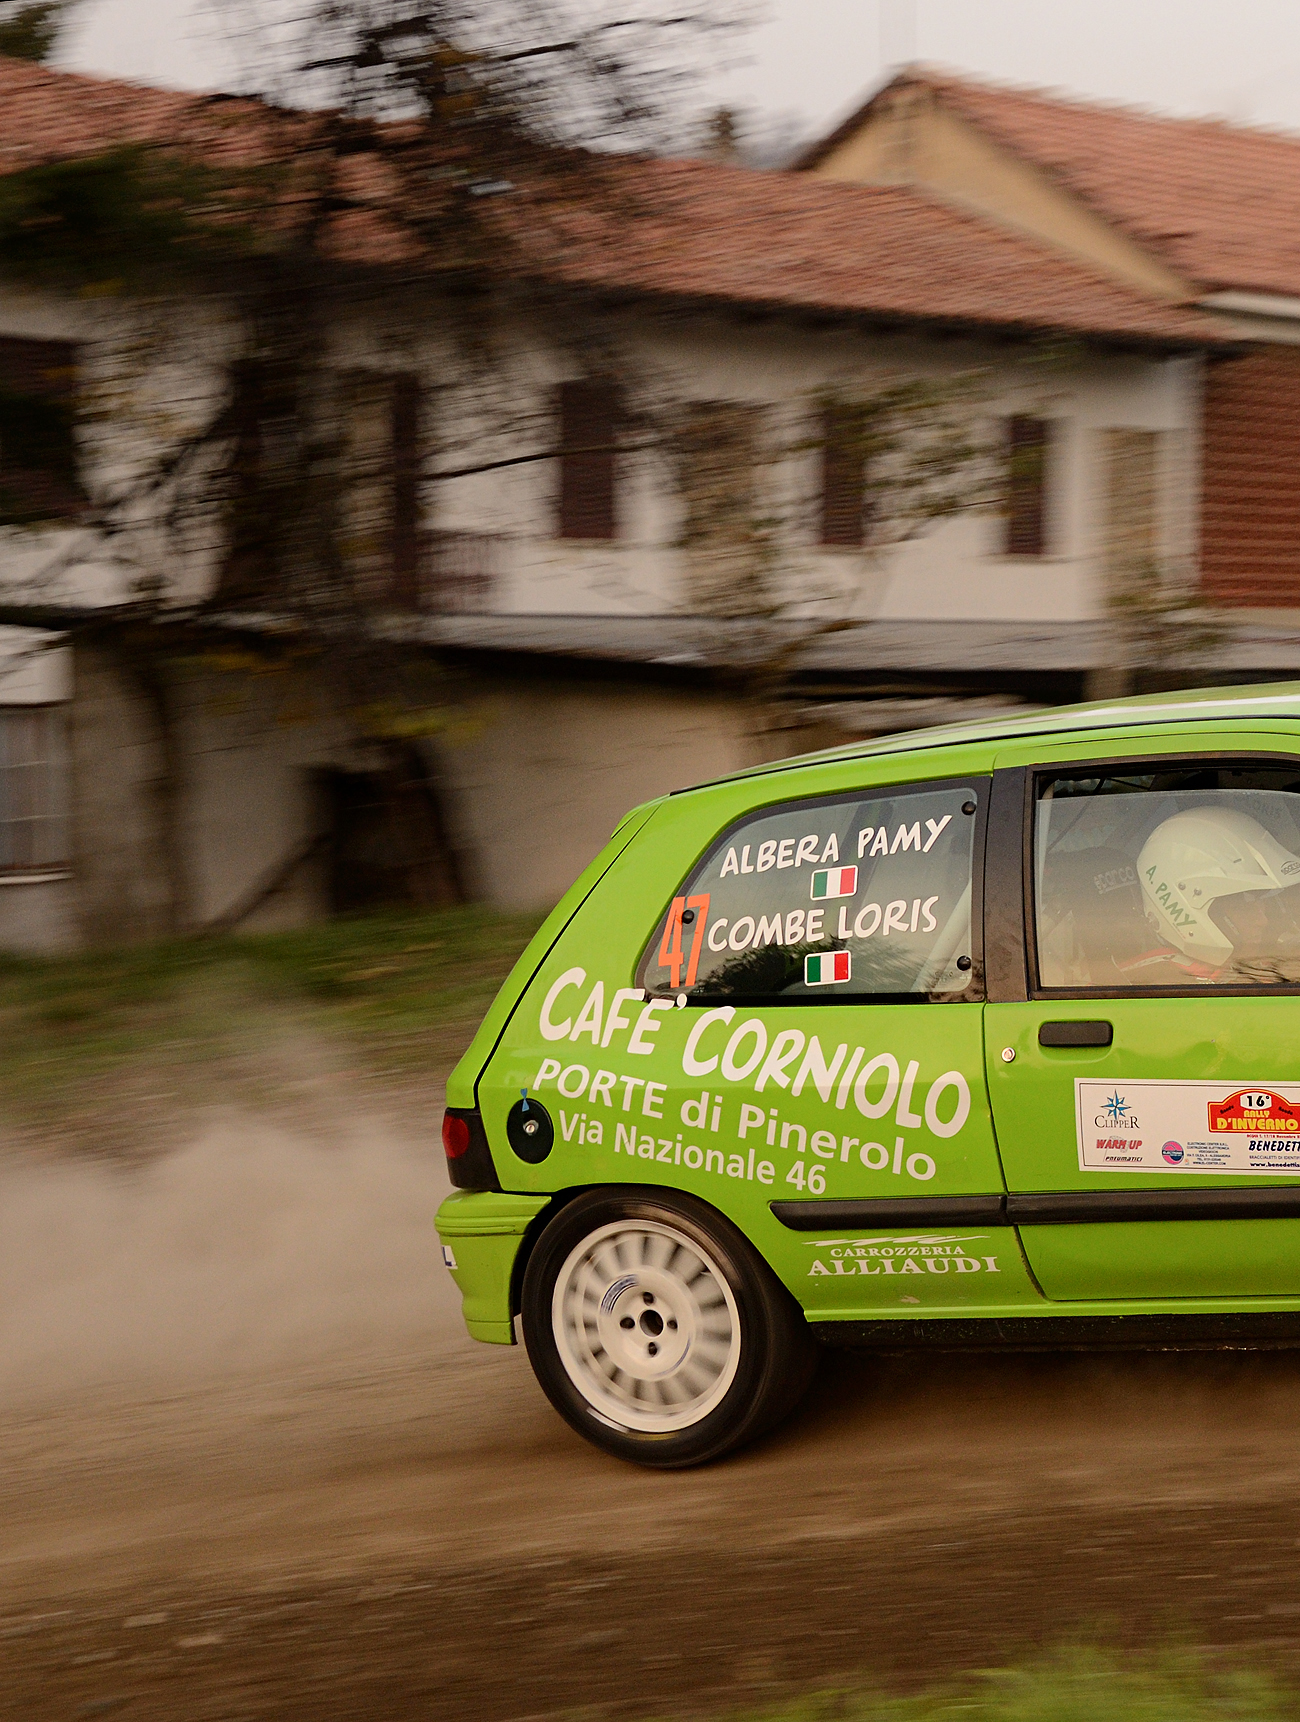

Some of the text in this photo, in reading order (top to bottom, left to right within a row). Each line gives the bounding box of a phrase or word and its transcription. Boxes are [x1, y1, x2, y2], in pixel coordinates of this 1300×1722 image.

[719, 815, 953, 878] ALBERA PAMY
[707, 895, 939, 952] COMBE LORIS
[1146, 865, 1197, 926] A. PAMY
[658, 893, 710, 989] 47
[681, 1005, 971, 1138] CORNIOLO
[533, 1058, 937, 1181] PORTE di Pinerolo
[1094, 1115, 1140, 1129] CLIPPER
[1216, 1117, 1299, 1131] D'INVERNO
[1243, 1109, 1270, 1118] RALLY
[558, 1109, 827, 1195] Via Nazionale 46
[1096, 1138, 1143, 1150] WARM UP
[807, 1256, 1001, 1276] ALLIAUDI
[830, 1246, 965, 1257] CARROZZERIA
